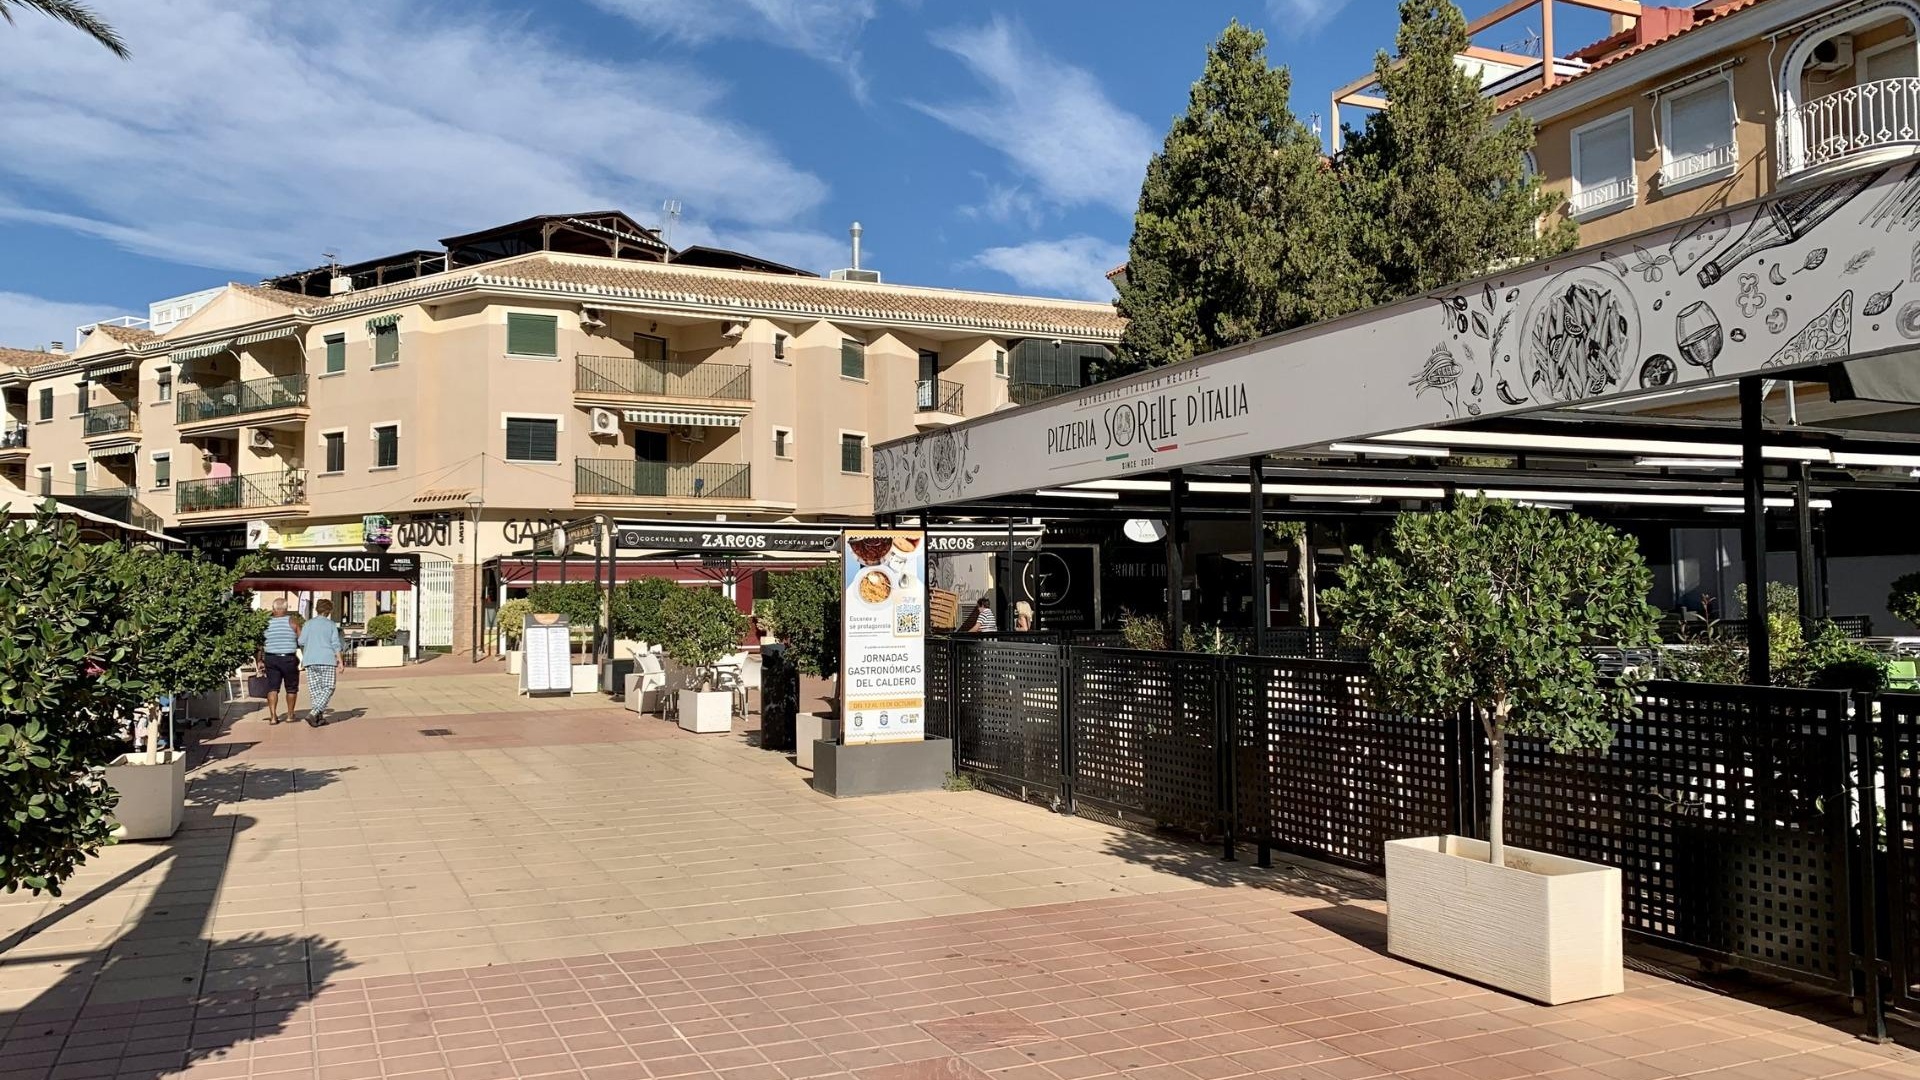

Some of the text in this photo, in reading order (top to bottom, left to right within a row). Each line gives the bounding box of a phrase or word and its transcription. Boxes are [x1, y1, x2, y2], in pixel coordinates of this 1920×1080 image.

[1079, 367, 1200, 406] AUTHENTIC ITALIAN RECIPE
[1048, 383, 1249, 454] PIZZERIA SORELLE D'ITALIA
[1121, 459, 1137, 470] SINCE
[702, 533, 766, 548] ZARCOS
[927, 537, 975, 550] ARCOS
[284, 556, 316, 564] PIZZERIA
[328, 557, 380, 572] GARDEN
[857, 623, 891, 631] protagonista
[861, 653, 909, 663] JORNADAS
[848, 664, 922, 676] GASTRONÓMICAS
[856, 677, 917, 688] DEL CALDERO
